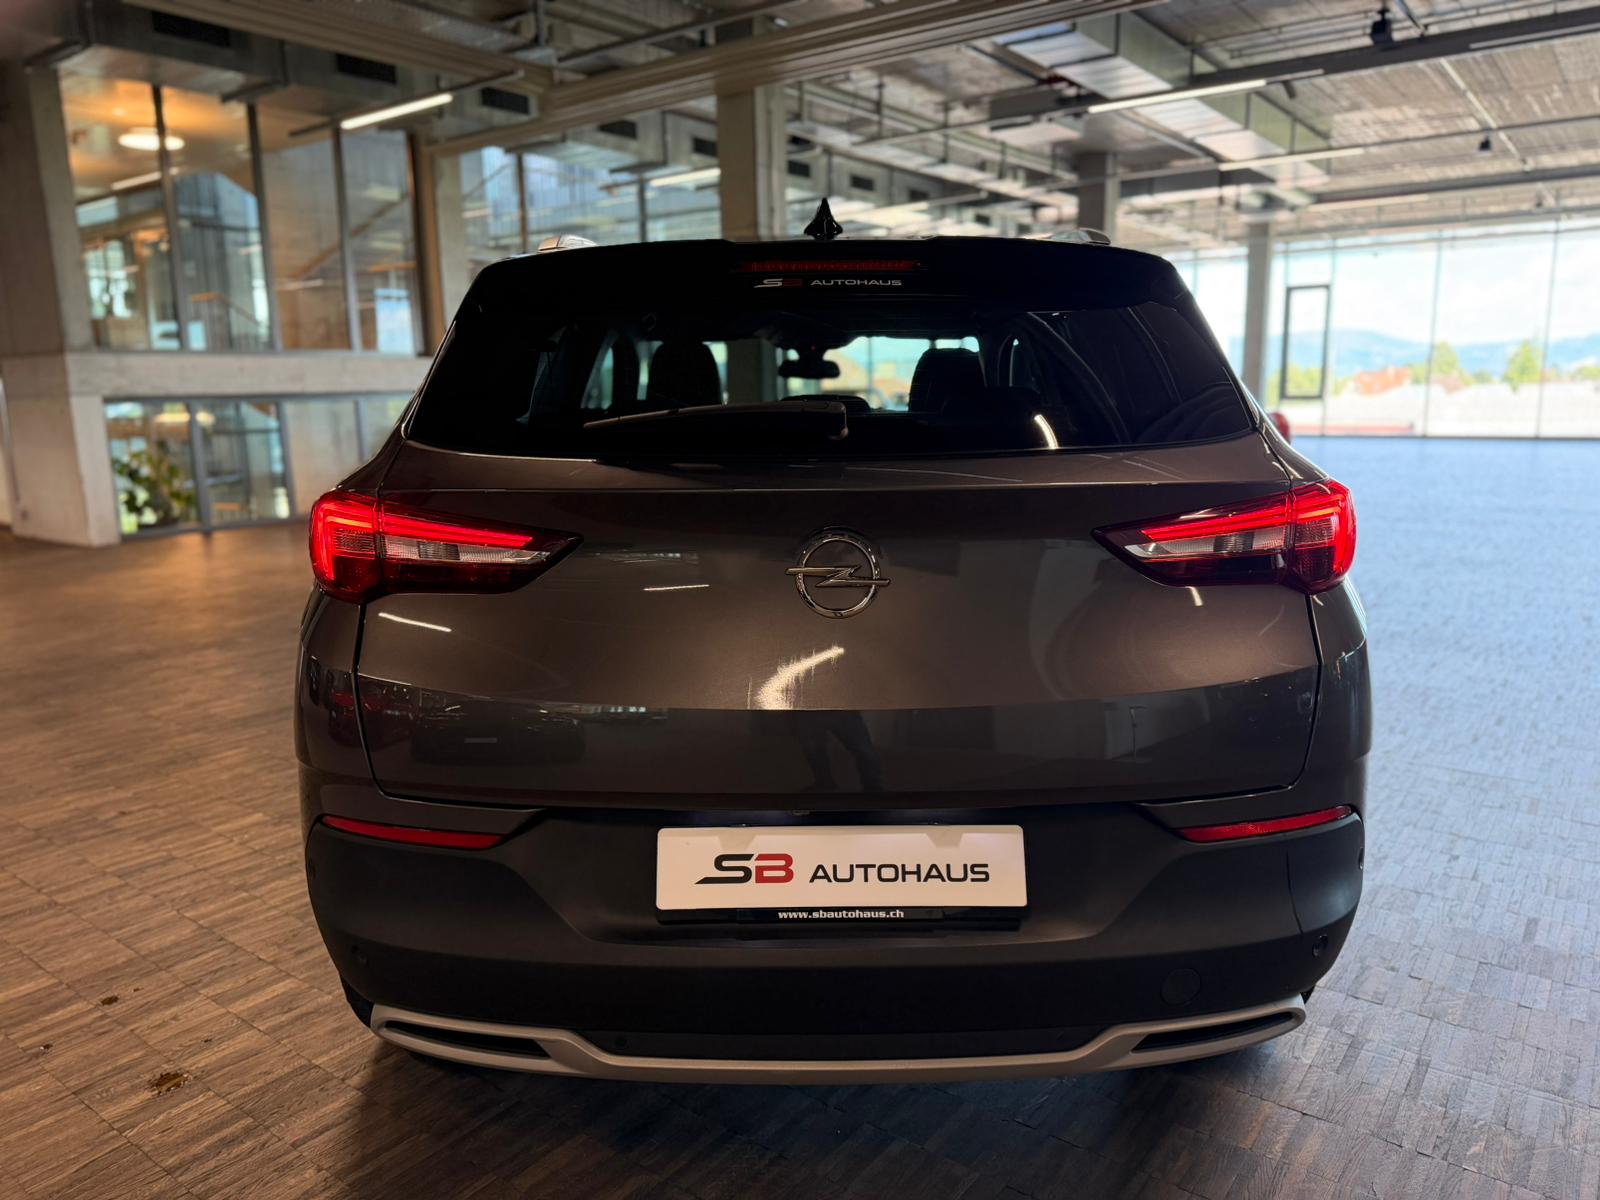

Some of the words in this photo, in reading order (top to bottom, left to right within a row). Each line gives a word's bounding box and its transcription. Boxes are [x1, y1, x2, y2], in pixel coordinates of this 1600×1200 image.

[695, 853, 794, 884] SB
[809, 863, 990, 883] AUTOHAUS
[778, 909, 904, 920] www.sbautohaus.ch
